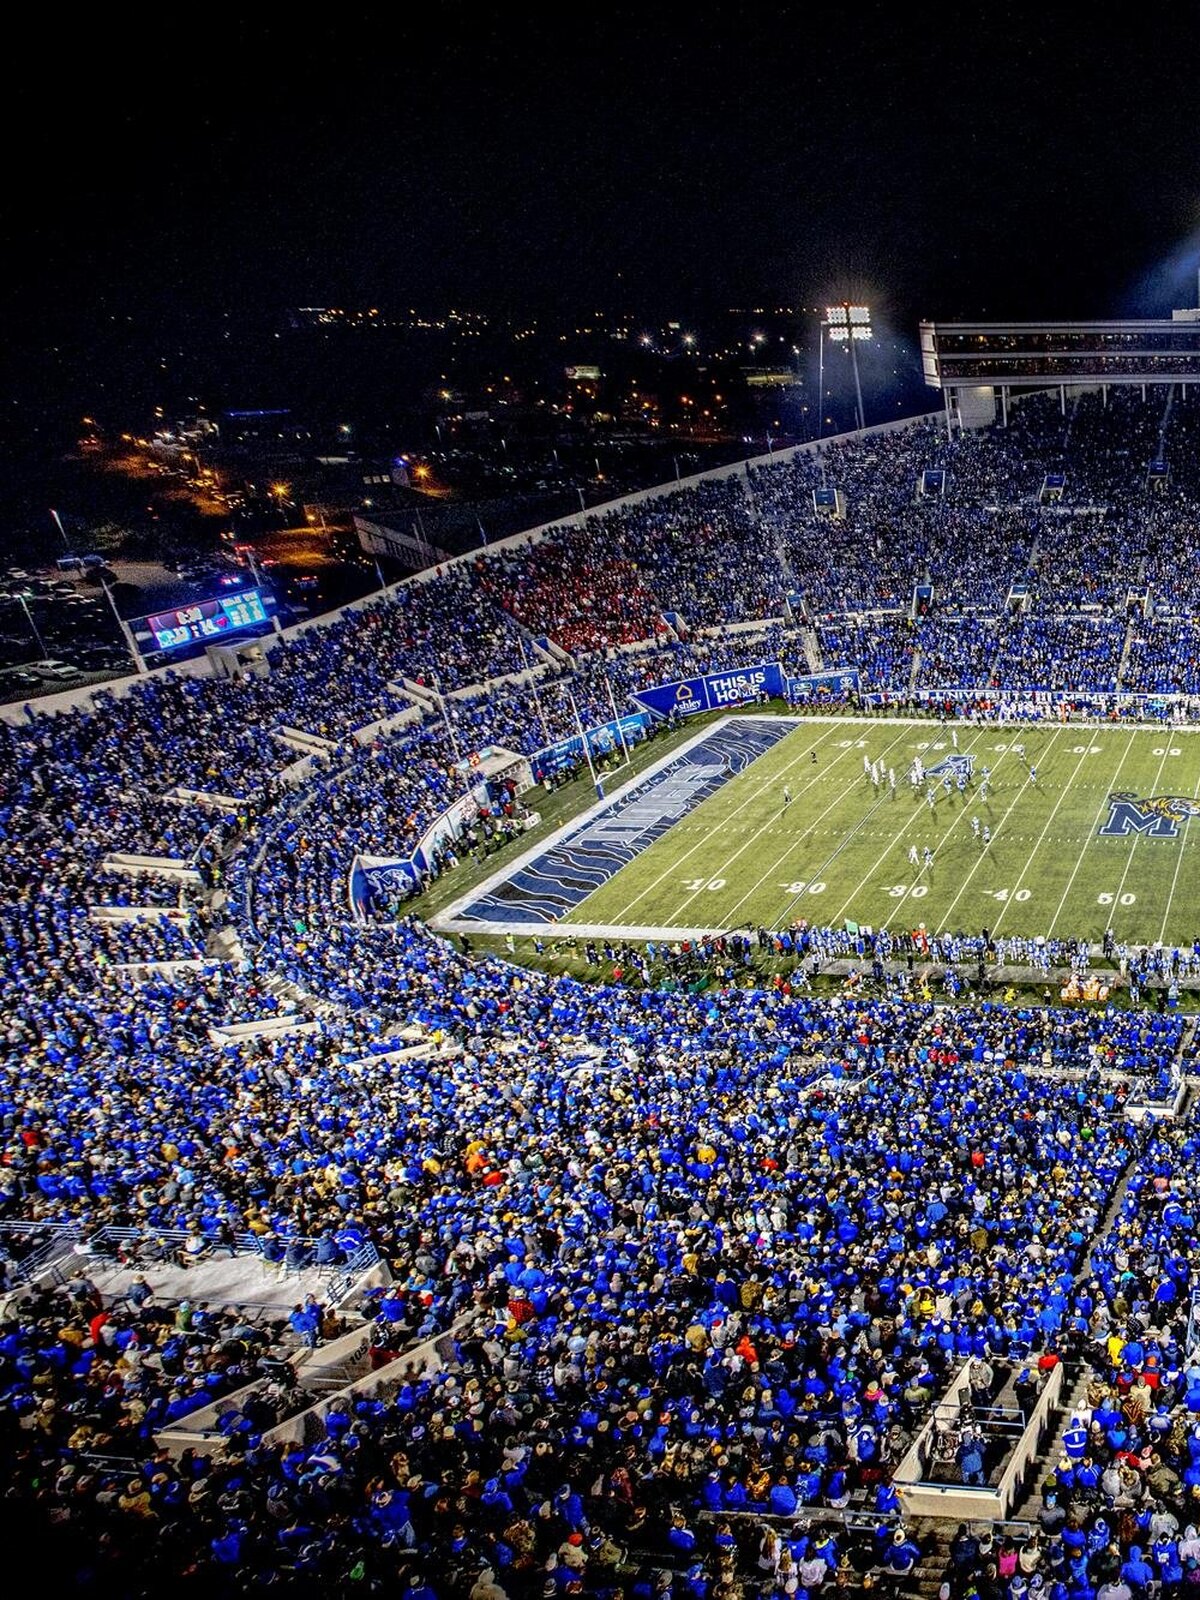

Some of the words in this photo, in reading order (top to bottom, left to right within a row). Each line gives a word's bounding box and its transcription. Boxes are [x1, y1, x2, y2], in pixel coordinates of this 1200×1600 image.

[709, 676, 747, 692] THIS
[750, 672, 766, 684] IS
[672, 699, 702, 711] Ashley
[469, 755, 480, 767] 25
[685, 878, 726, 891] 10
[784, 881, 826, 894] 20
[888, 885, 929, 898] 30
[992, 888, 1032, 901] 40
[1096, 892, 1136, 905] 50
